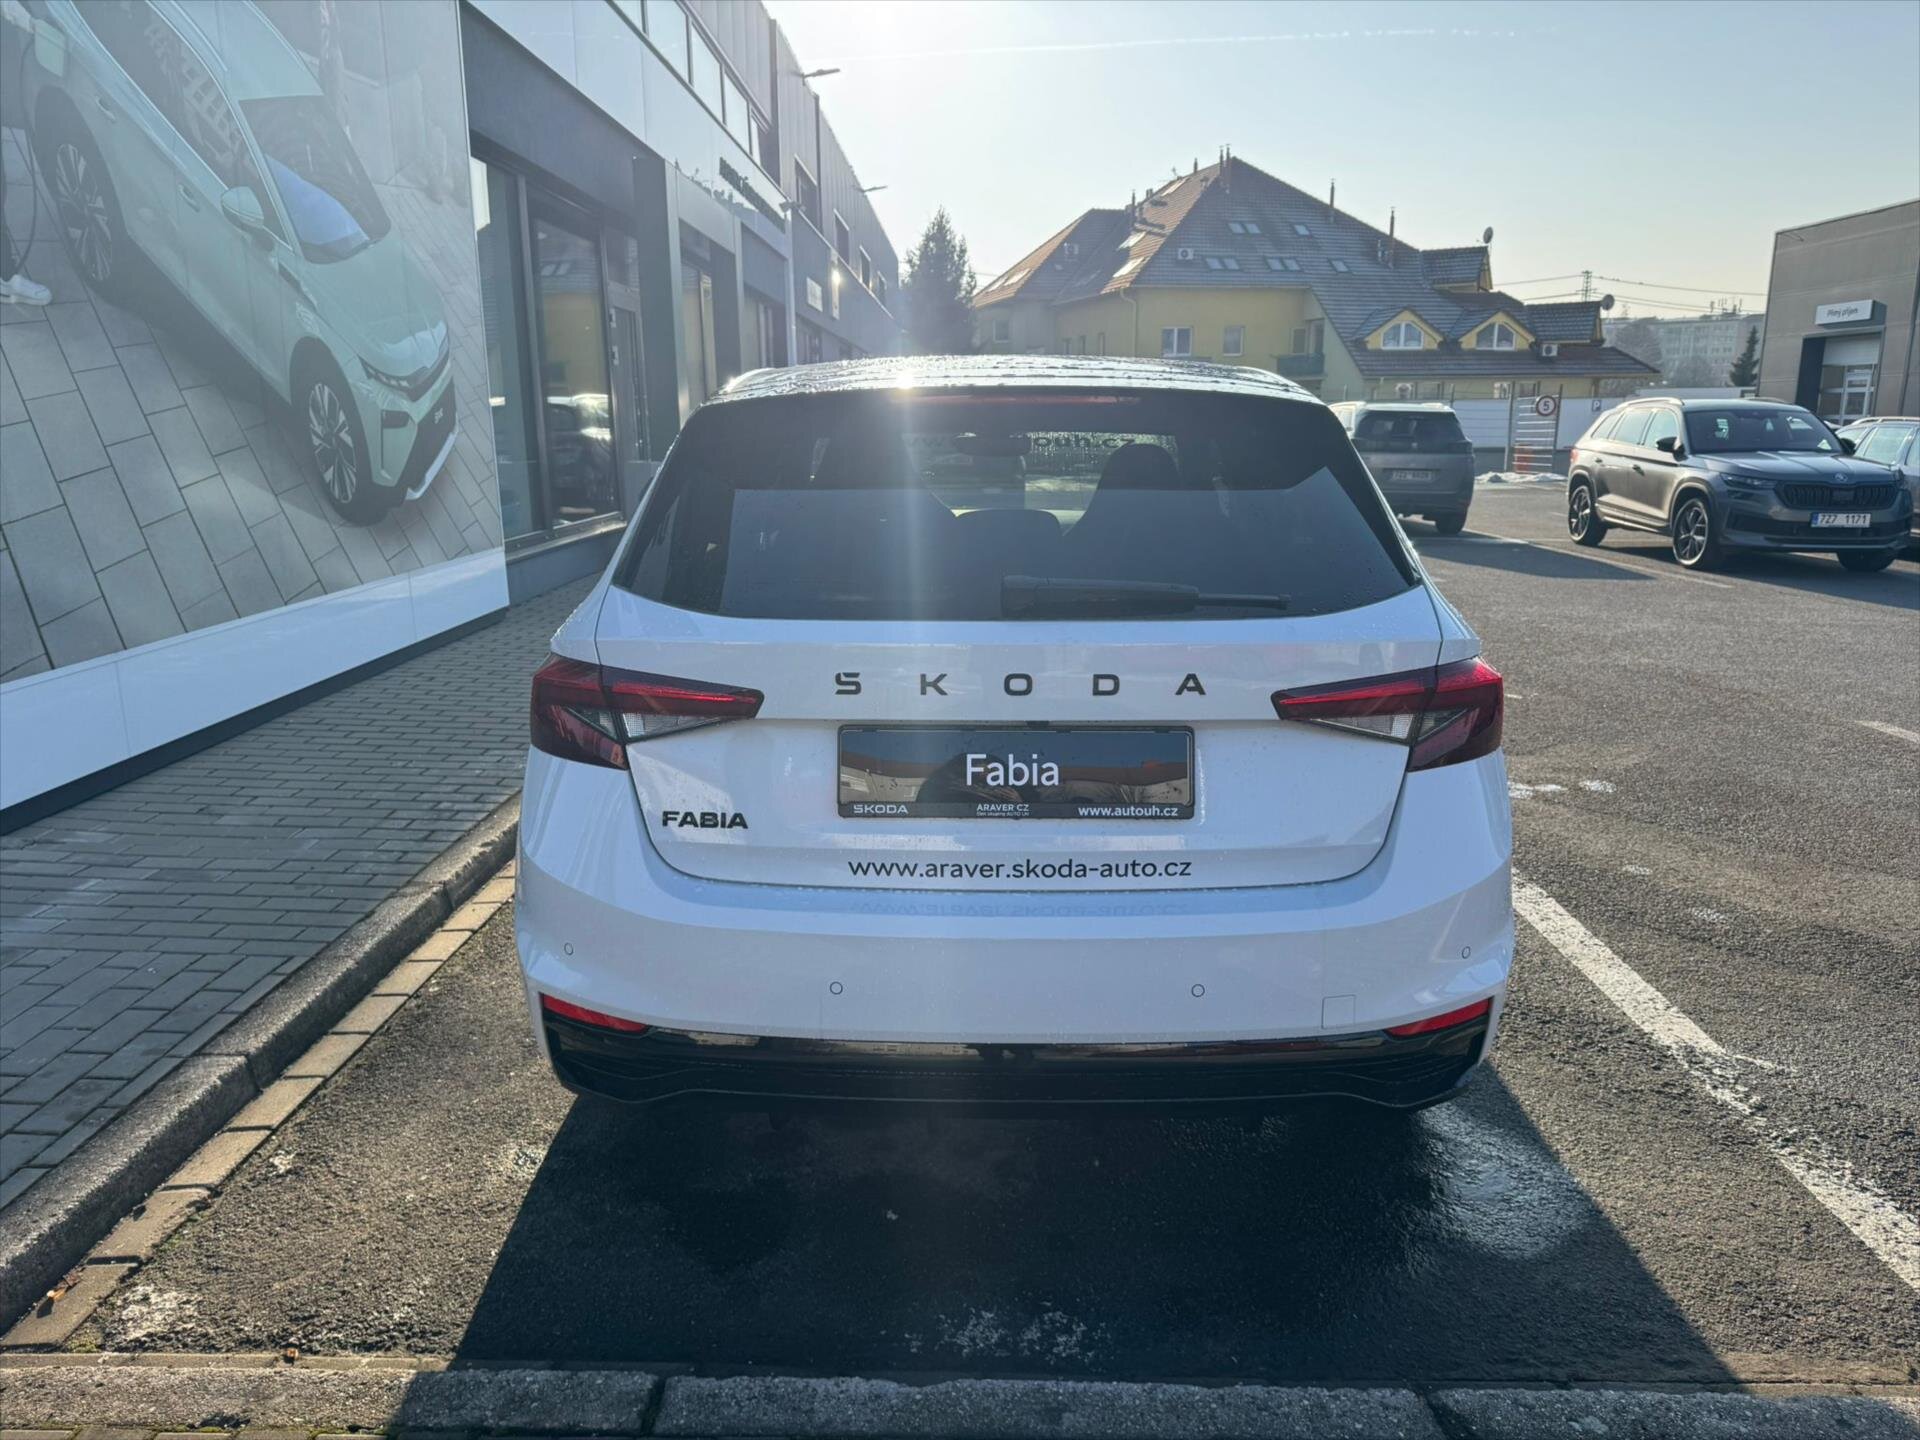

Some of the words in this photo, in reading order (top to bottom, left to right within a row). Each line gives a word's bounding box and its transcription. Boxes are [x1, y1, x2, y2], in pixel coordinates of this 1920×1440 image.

[1543, 400, 1551, 411] 5
[1593, 400, 1601, 411] P
[1845, 514, 1867, 524] 1171
[964, 753, 1060, 788] Fabia
[976, 803, 1014, 812] ARAVER
[1016, 803, 1030, 812] CZ
[1077, 804, 1179, 817] www.autouh.cz
[662, 811, 749, 829] FABIA
[848, 858, 1192, 878] www.araver.skoda-auto.cz
